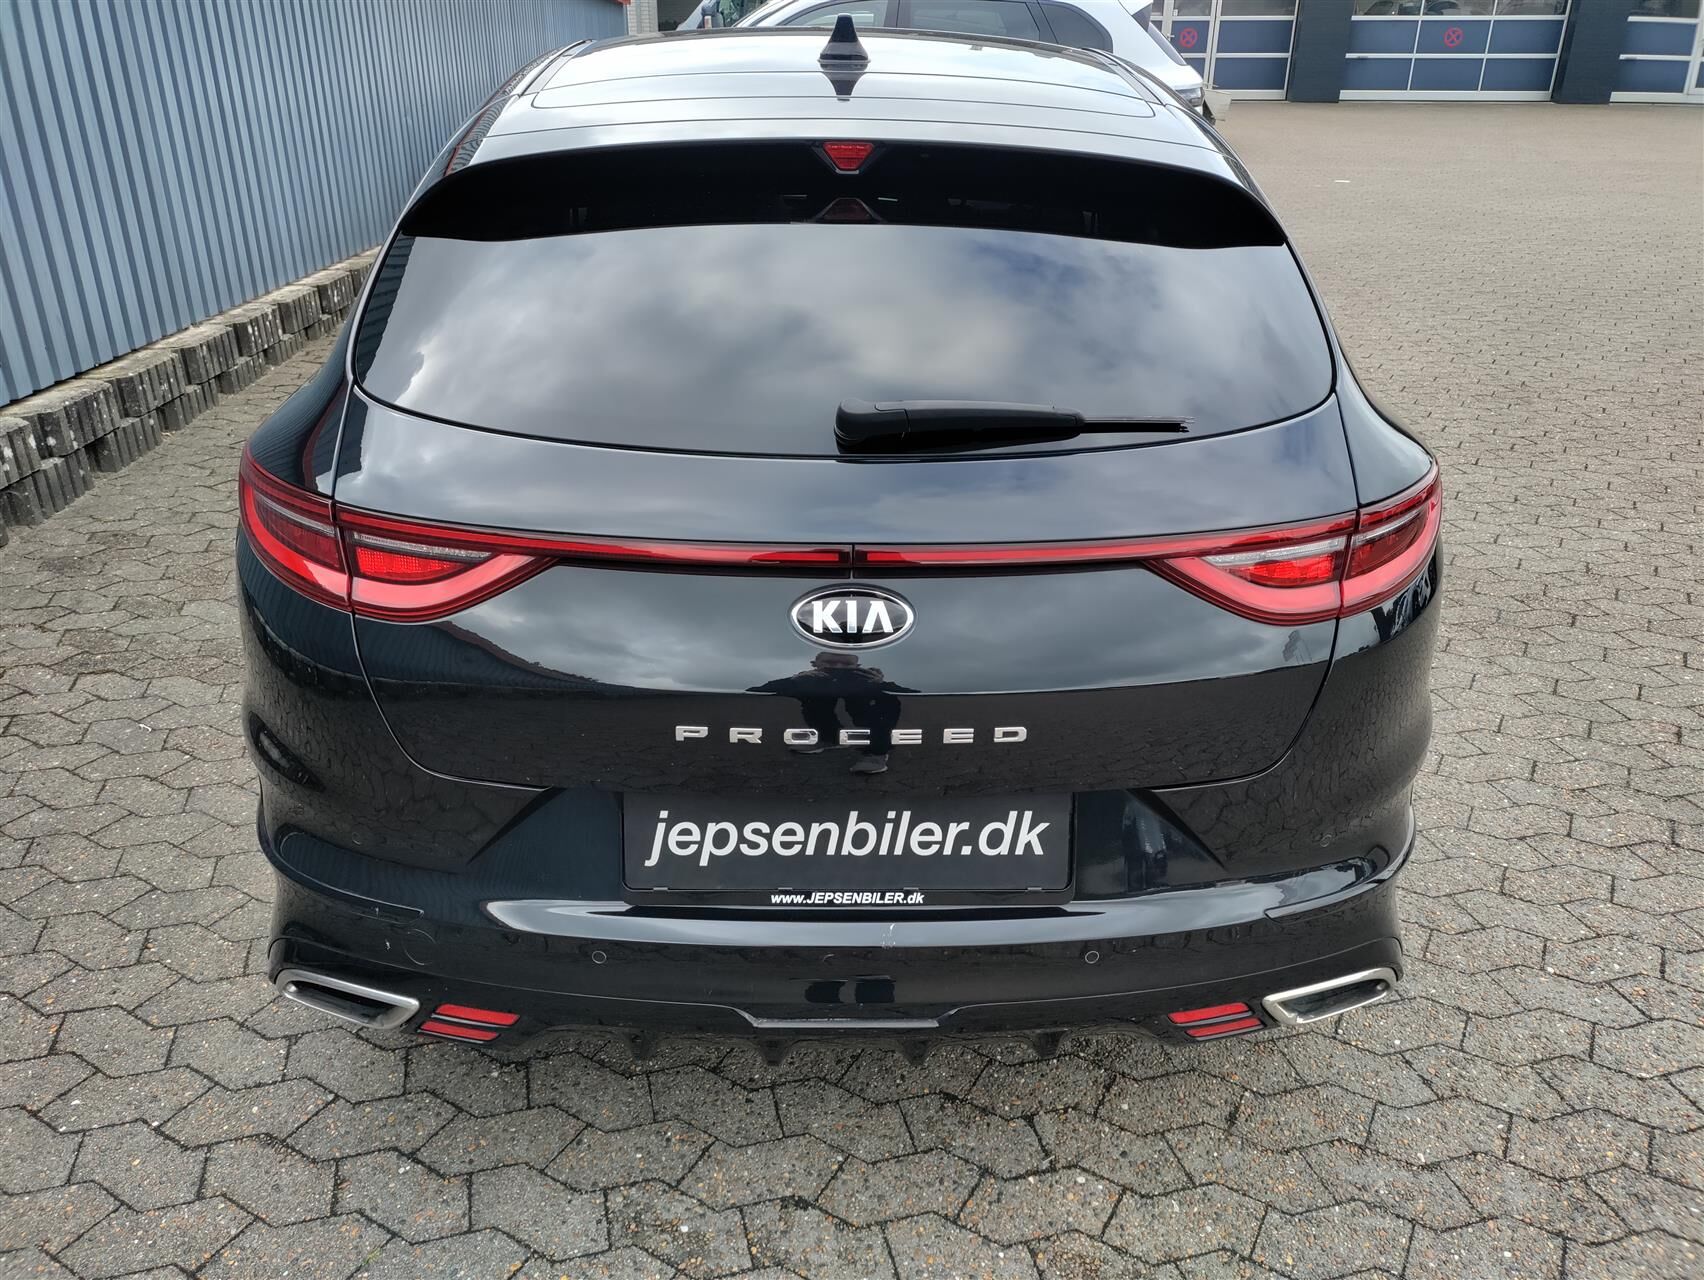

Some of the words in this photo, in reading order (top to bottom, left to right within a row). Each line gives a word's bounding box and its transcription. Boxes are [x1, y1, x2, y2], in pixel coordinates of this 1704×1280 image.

[812, 600, 894, 634] KIA
[675, 725, 1028, 745] PROCEED
[644, 810, 1050, 867] jepsenbiler.dk
[770, 892, 925, 905] www.JEPSENBILER.dk
